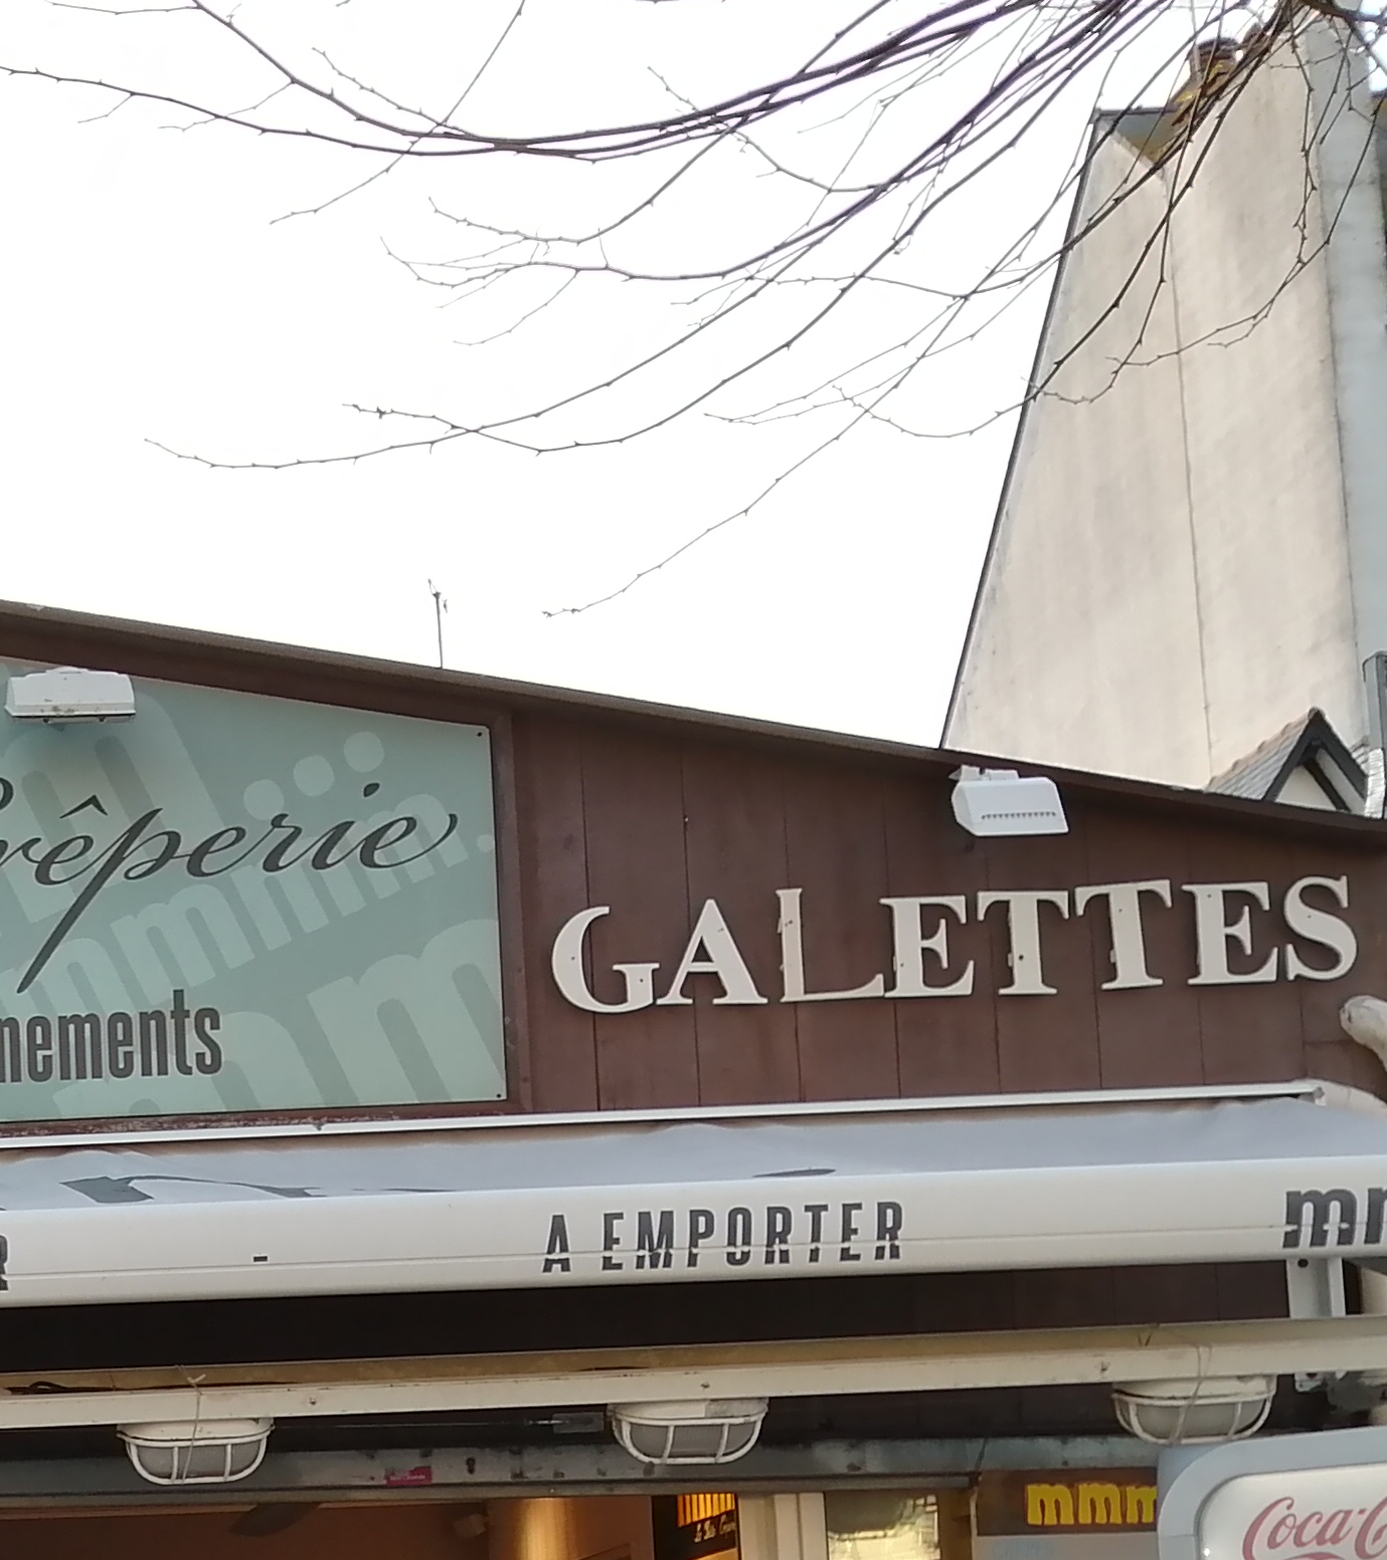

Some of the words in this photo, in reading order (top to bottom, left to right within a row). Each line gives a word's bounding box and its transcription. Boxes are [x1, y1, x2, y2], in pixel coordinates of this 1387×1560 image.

[551, 874, 1359, 1014] GALETTES
[542, 1213, 572, 1274] A
[601, 1200, 905, 1271] EMPORTER
